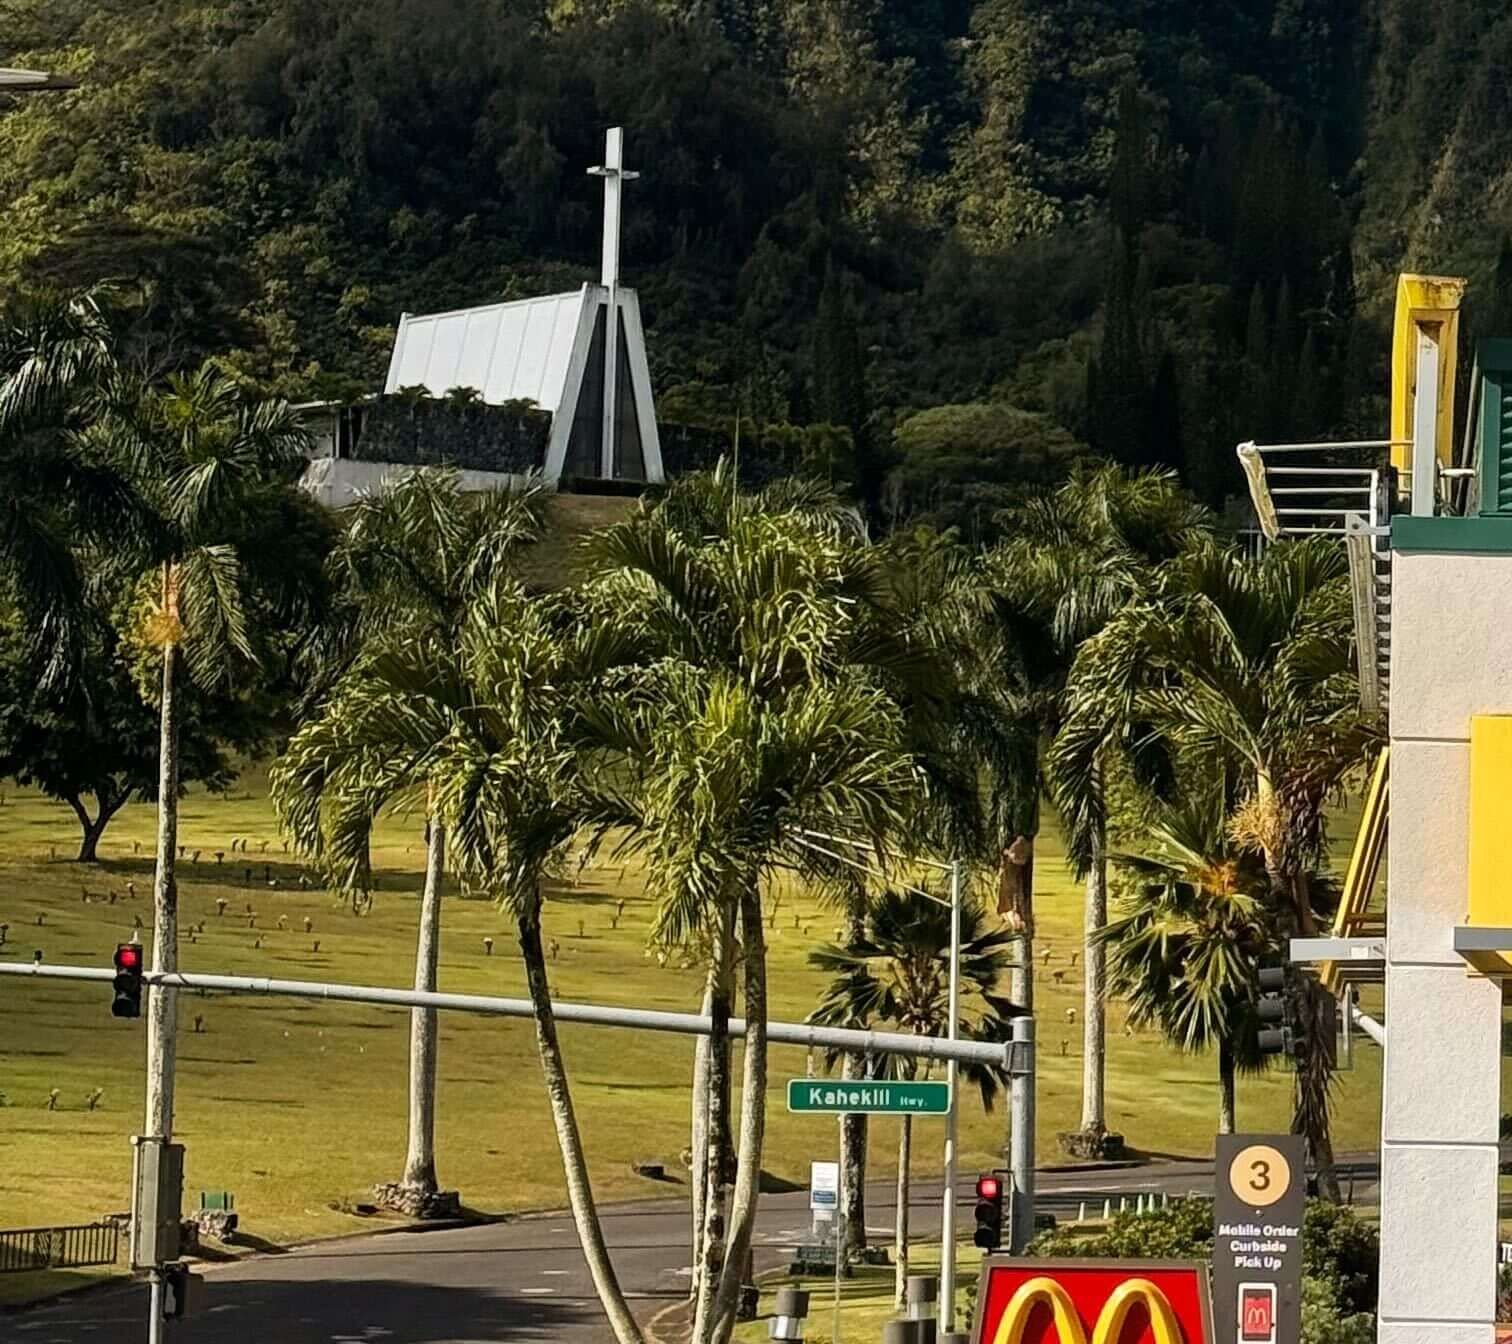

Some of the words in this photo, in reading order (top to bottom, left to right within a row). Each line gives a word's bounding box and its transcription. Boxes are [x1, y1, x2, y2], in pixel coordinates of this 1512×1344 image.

[809, 1088, 890, 1106] Kahekili
[1249, 1160, 1270, 1191] 3
[1219, 1224, 1261, 1236] Mobile
[1262, 1224, 1299, 1237] Order
[1230, 1240, 1287, 1253] Curbside
[1234, 1256, 1262, 1268] Pick
[1263, 1256, 1282, 1271] Up
